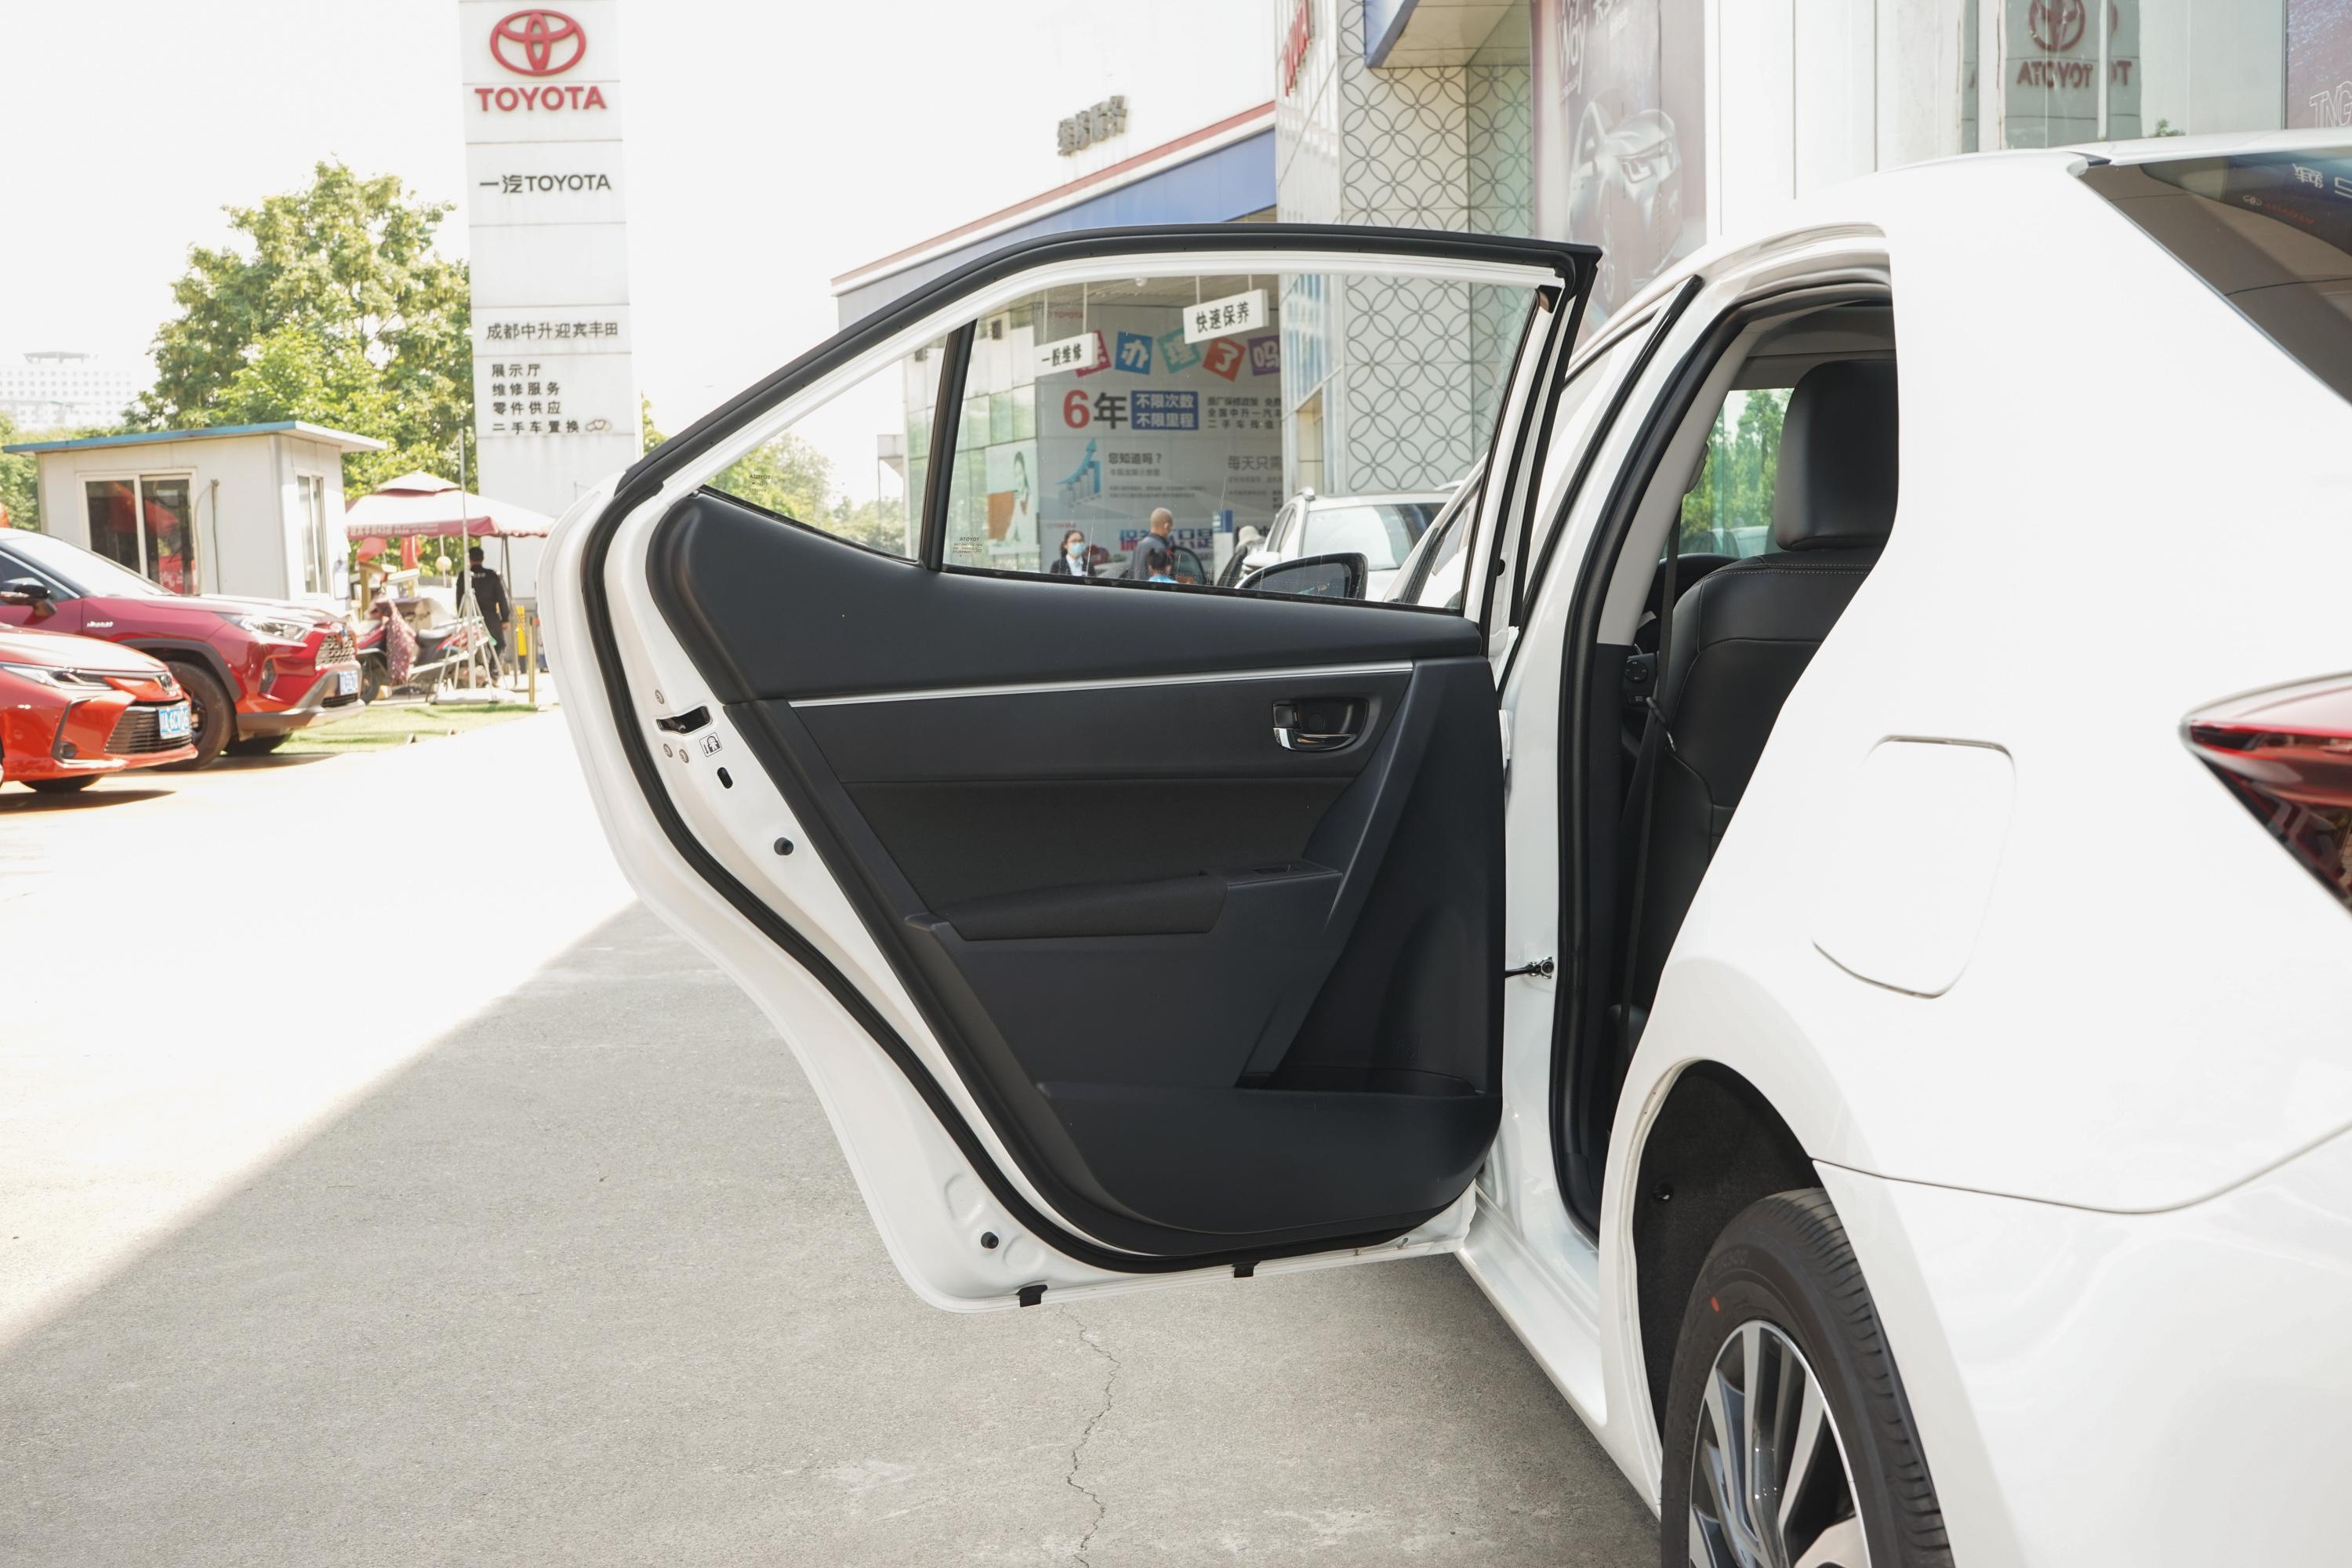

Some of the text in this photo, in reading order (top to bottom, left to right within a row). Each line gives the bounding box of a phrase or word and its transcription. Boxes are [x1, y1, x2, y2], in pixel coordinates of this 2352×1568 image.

[474, 85, 607, 111] TOYOTA
[479, 173, 612, 194] 一汽TOYOTA
[1196, 300, 1250, 333] 快速保养
[486, 321, 619, 340] 成都中升迎宾丰田
[1041, 342, 1083, 367] 一般维修
[492, 364, 541, 378] 展示厅
[492, 382, 560, 397] 维修服务
[493, 401, 561, 416] 零件供应
[1063, 389, 1129, 430] 6年
[1136, 394, 1194, 408] 不限次数
[492, 420, 579, 435] 二手车置换
[1136, 412, 1194, 428] 不限里程
